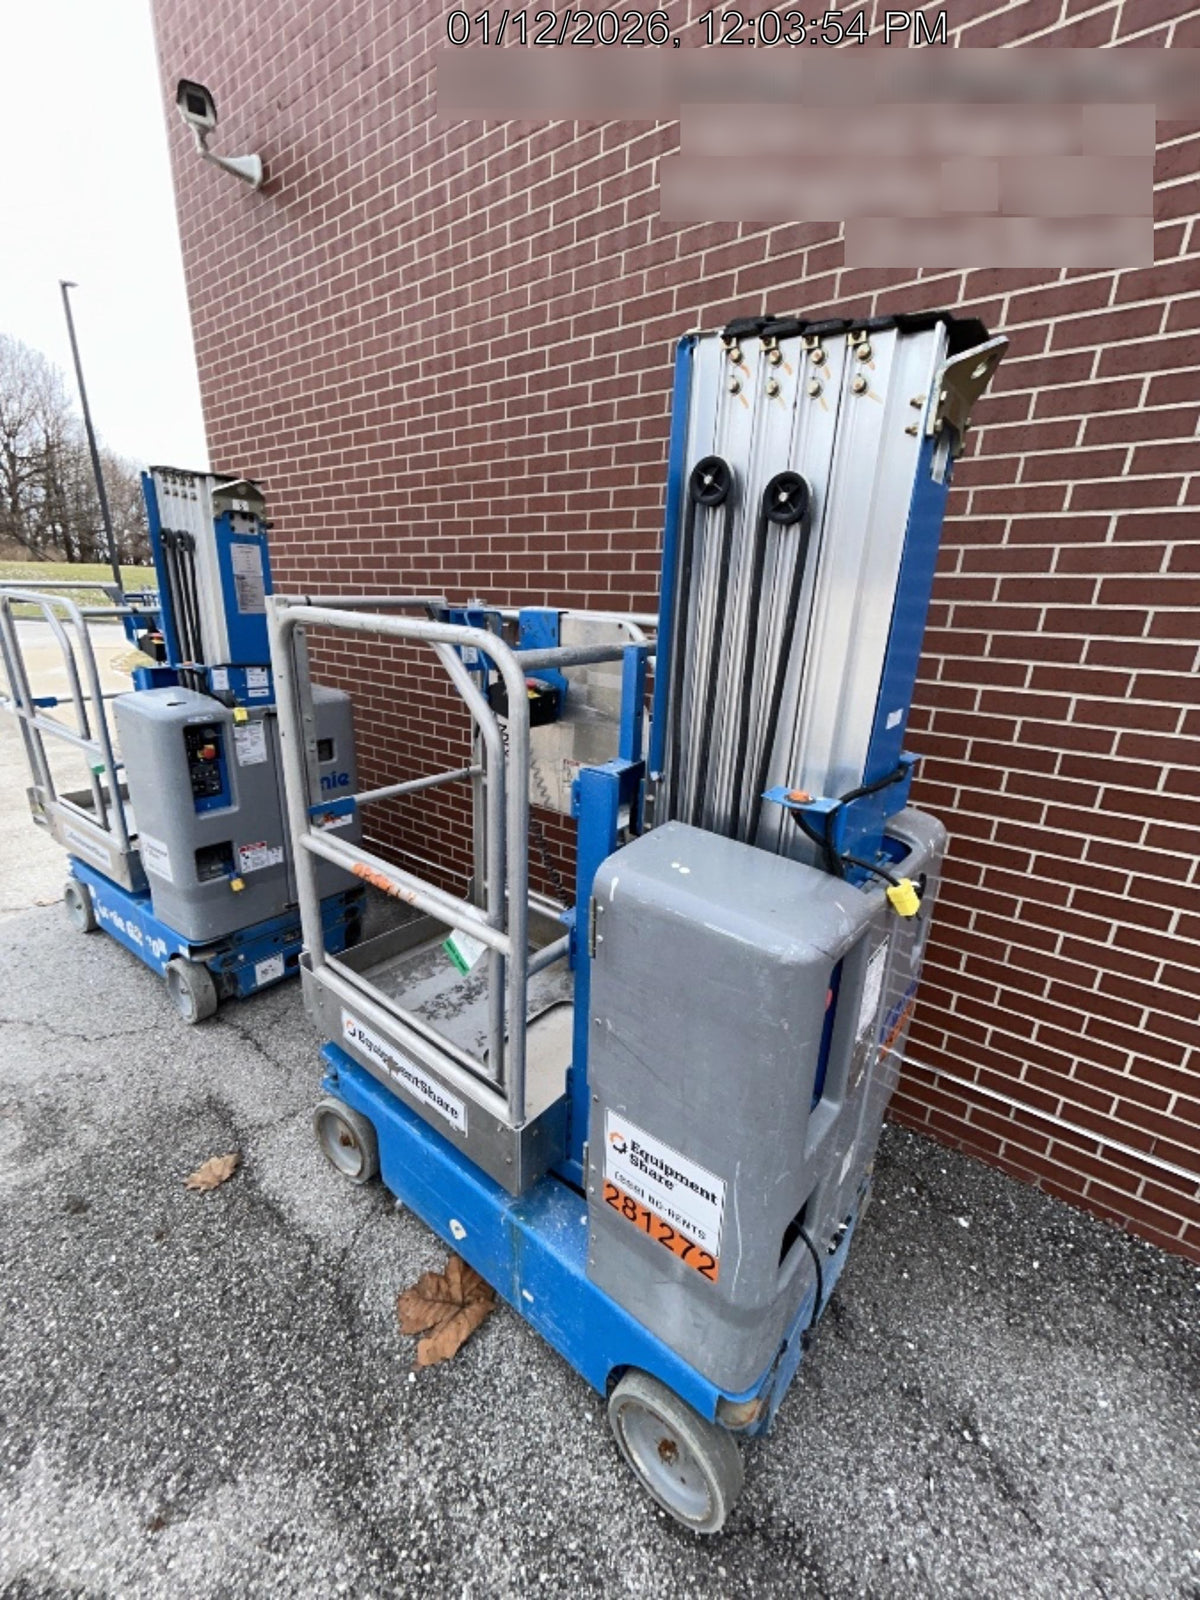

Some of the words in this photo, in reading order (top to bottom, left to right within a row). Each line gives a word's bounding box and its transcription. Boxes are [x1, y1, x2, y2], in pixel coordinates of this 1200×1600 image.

[320, 770, 349, 791] nie
[358, 1029, 459, 1119] EquientShare
[630, 1153, 674, 1191] Share
[630, 1139, 717, 1206] Equipment
[605, 1183, 716, 1281] 281272
